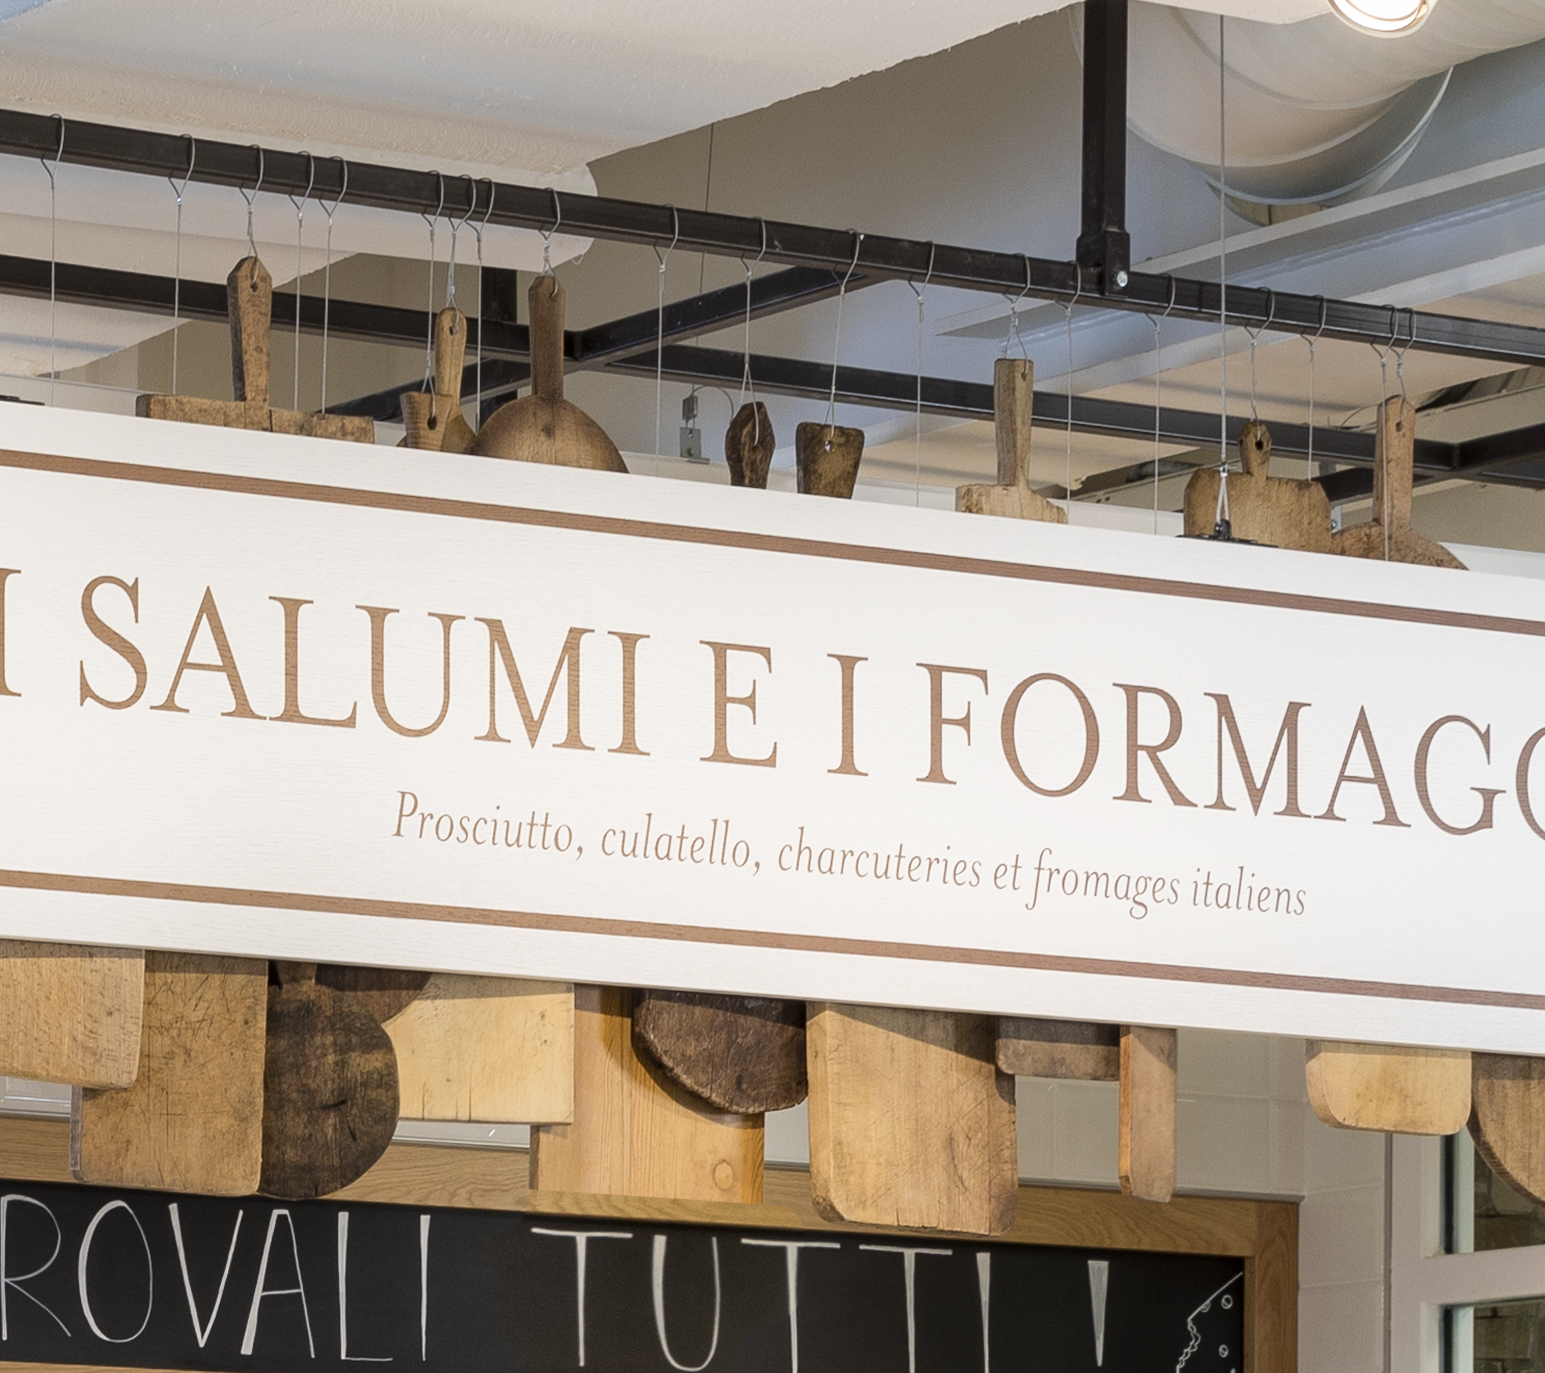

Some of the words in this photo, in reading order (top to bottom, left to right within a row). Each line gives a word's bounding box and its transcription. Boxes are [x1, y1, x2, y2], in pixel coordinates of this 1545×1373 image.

[79, 575, 651, 757] SALUMI
[700, 640, 778, 769] E
[826, 652, 868, 778] I
[392, 790, 585, 861] Prosciutto,
[601, 813, 763, 878] culatello,
[778, 826, 983, 890] charcuteries
[994, 847, 1023, 890] et
[1026, 846, 1180, 921] fromages
[1191, 864, 1307, 918] italiens
